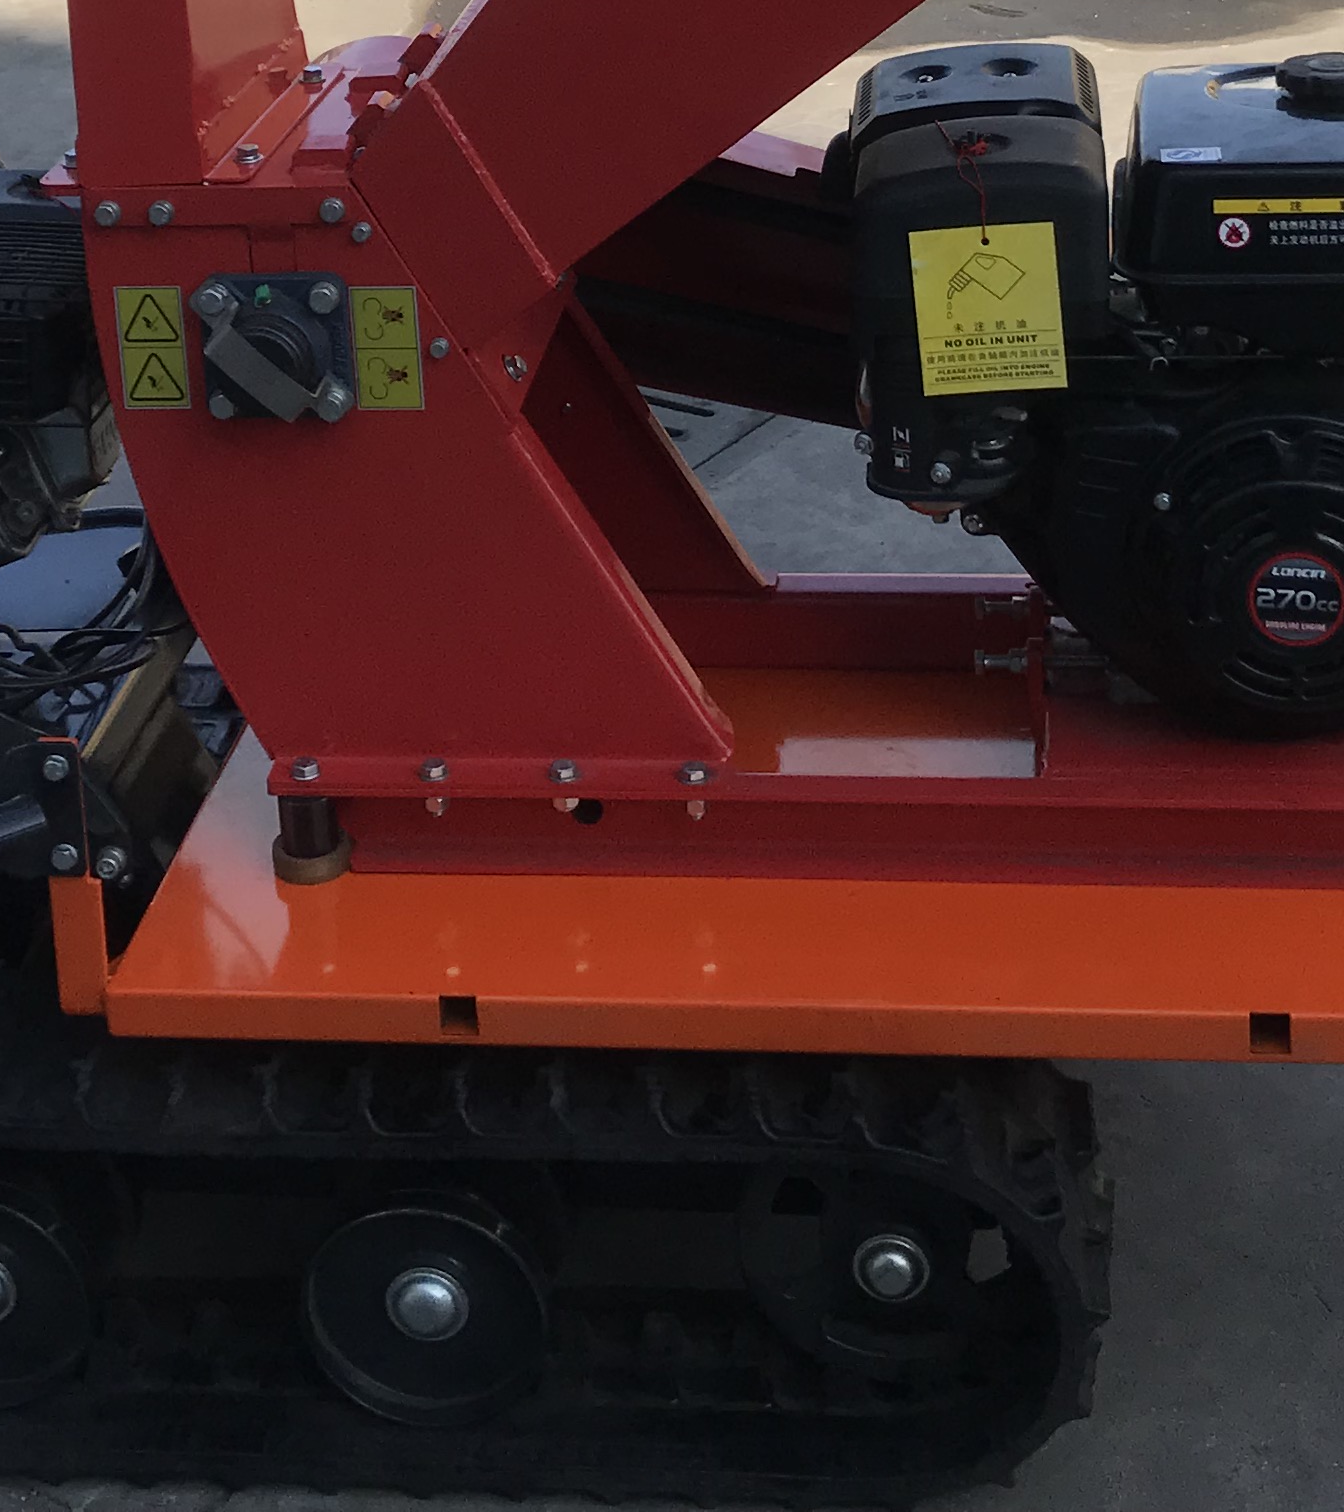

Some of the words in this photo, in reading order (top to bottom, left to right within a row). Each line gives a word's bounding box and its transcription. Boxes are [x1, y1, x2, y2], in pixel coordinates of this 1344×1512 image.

[944, 339, 963, 348] NO
[965, 337, 987, 347] OIL
[990, 336, 1004, 345] IN
[1006, 334, 1038, 344] UNIT
